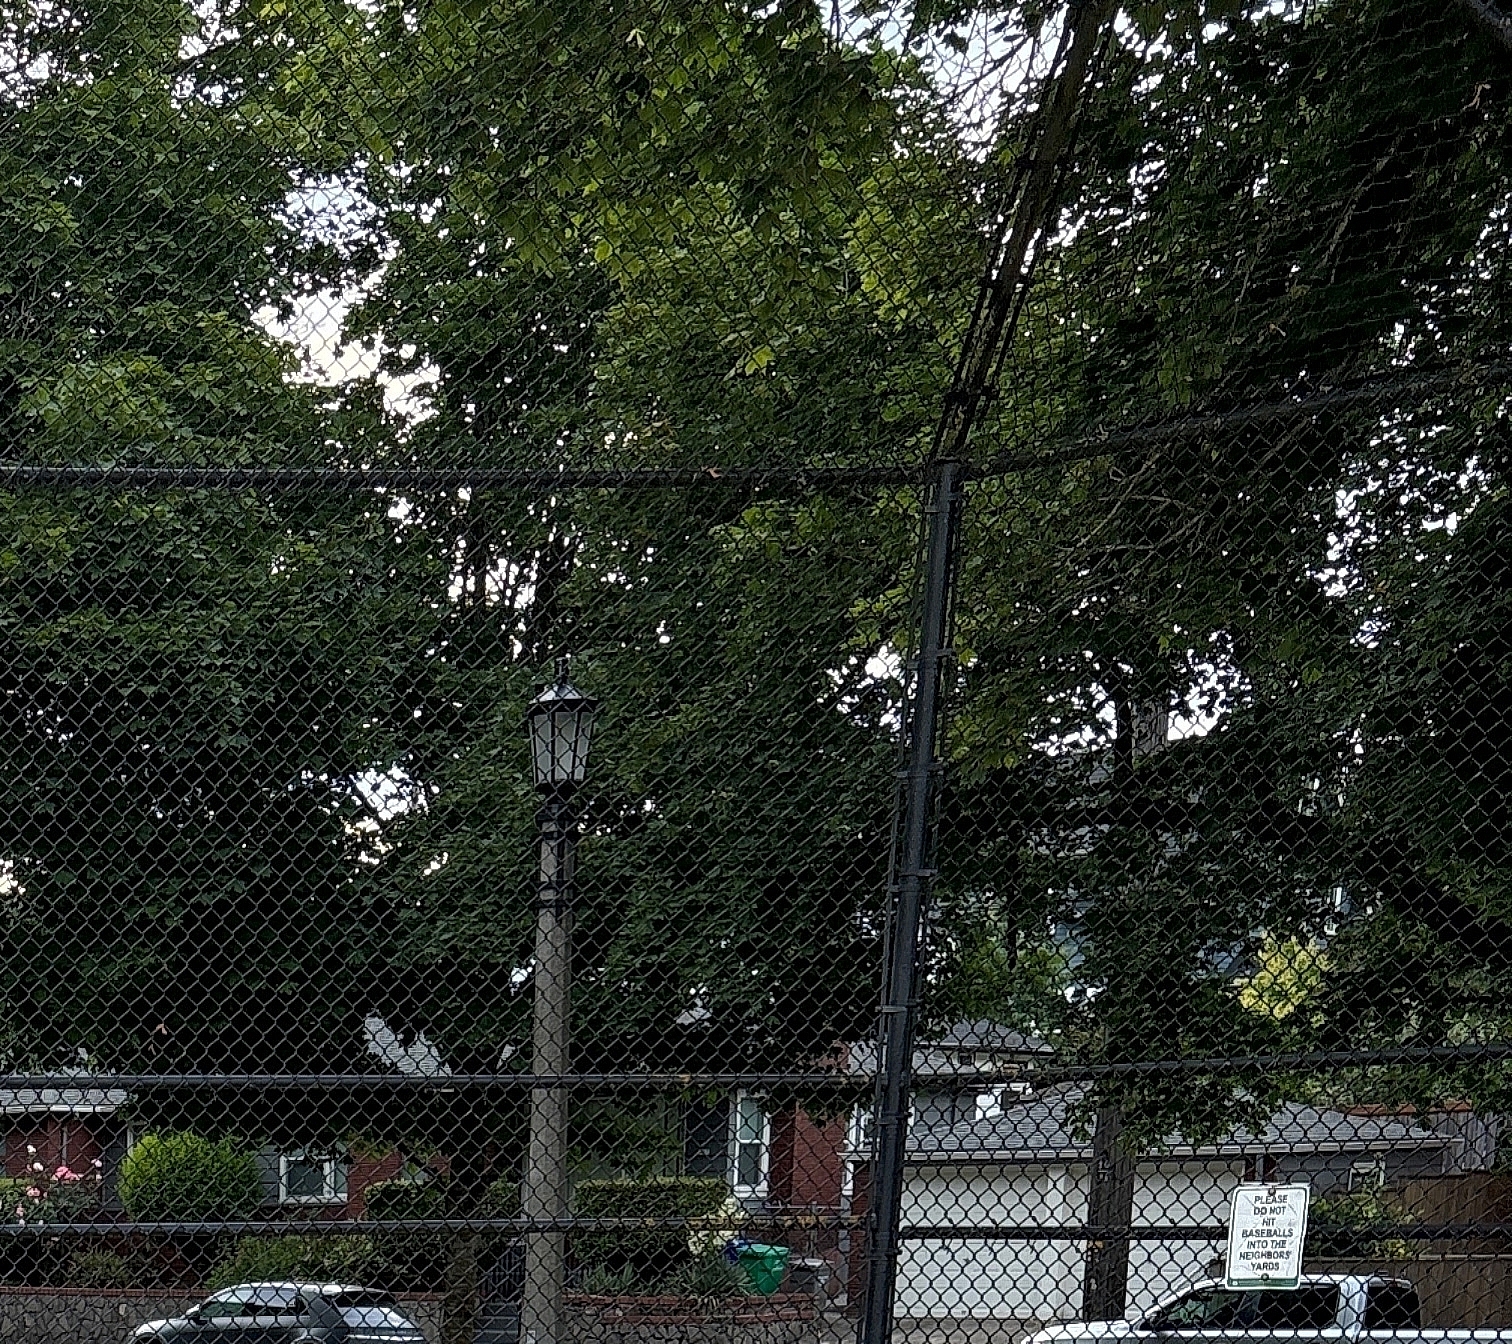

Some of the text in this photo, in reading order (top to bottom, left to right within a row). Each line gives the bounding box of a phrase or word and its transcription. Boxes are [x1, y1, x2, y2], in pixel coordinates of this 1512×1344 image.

[1254, 1195, 1288, 1204] PLEASE
[1253, 1206, 1286, 1215] DO NOT
[1262, 1217, 1276, 1226] HIT
[1241, 1228, 1294, 1238] BASEBALLS
[1247, 1239, 1287, 1249] INTO THE
[1250, 1262, 1280, 1271] YARDS
